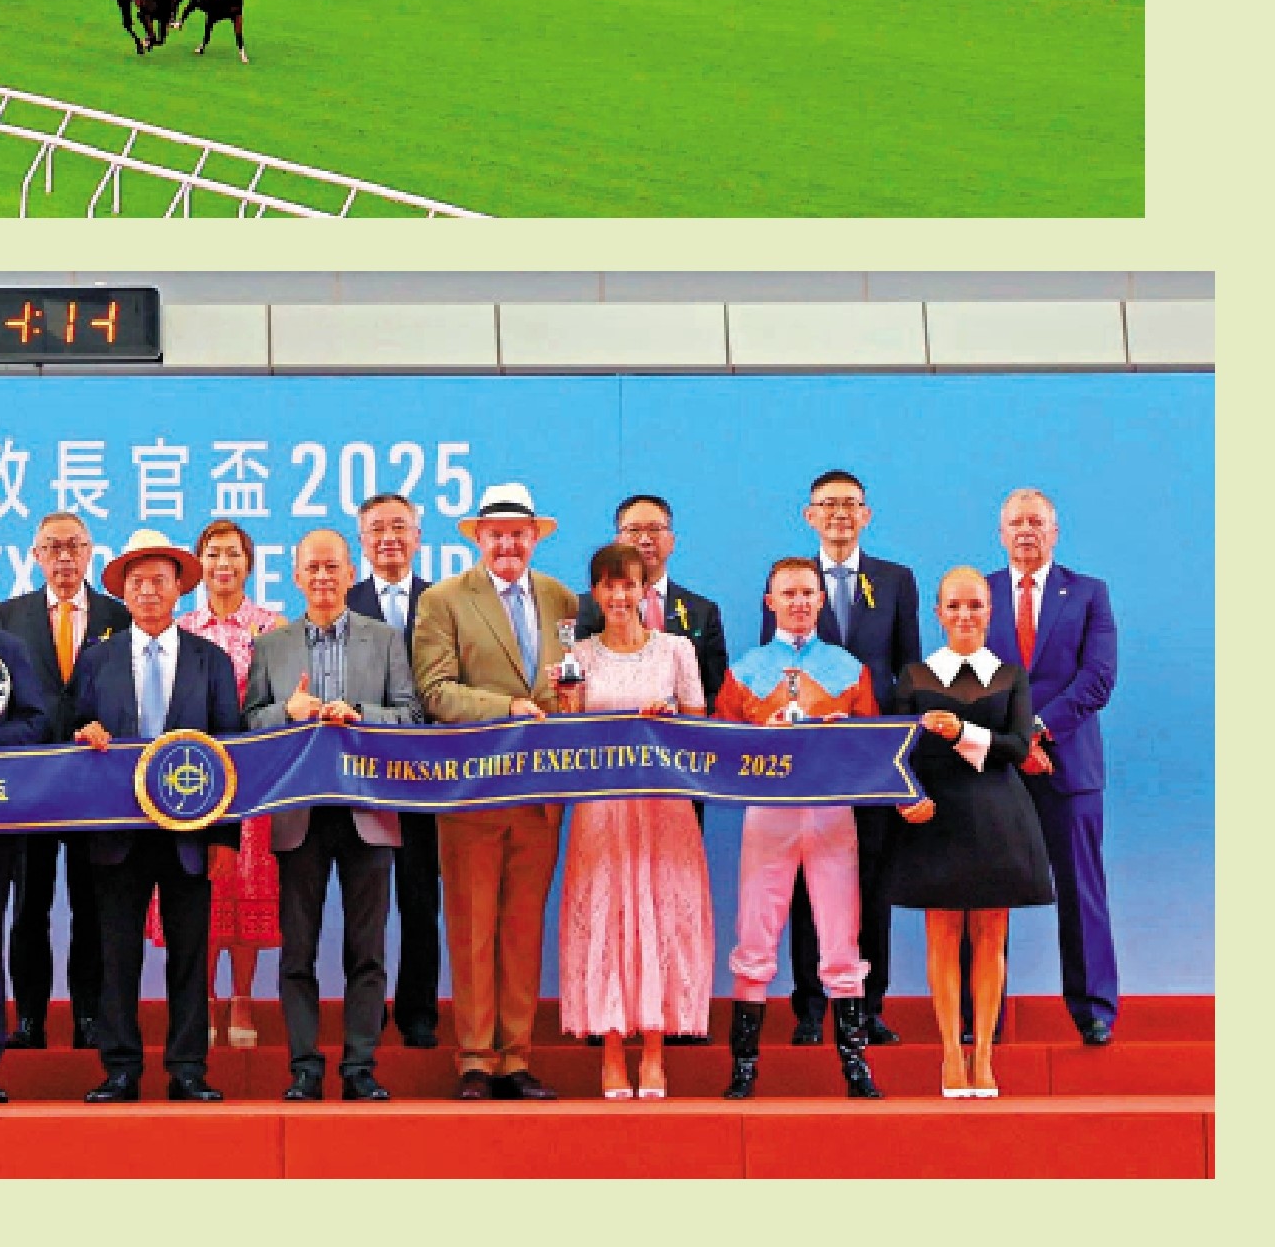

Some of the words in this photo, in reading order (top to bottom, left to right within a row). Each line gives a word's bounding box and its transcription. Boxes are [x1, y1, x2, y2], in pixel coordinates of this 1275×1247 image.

[340, 751, 380, 779] THE
[386, 759, 459, 781] HKSAR
[462, 751, 529, 780] CHIEF
[532, 745, 671, 773] EXECUTIVE'S
[674, 749, 718, 774] CUP
[738, 754, 793, 777] 2025
